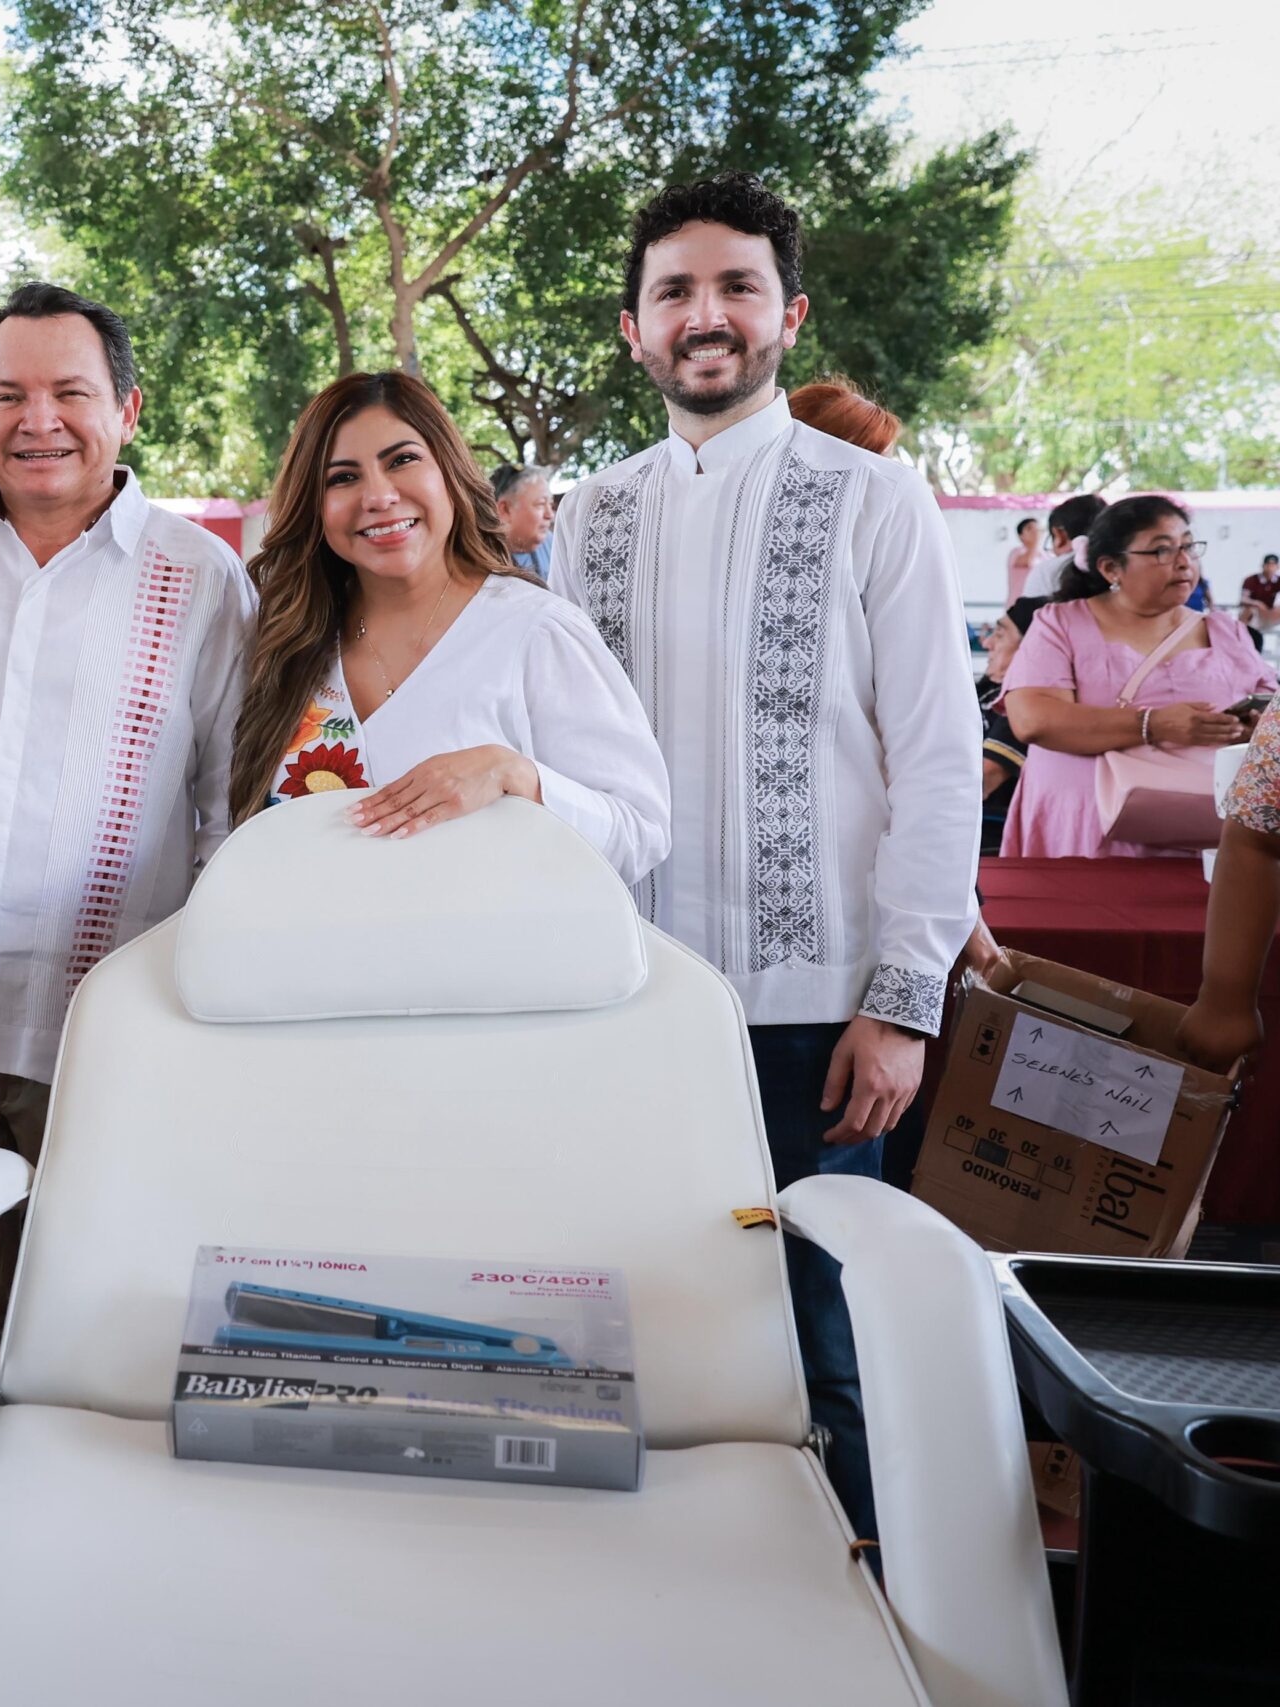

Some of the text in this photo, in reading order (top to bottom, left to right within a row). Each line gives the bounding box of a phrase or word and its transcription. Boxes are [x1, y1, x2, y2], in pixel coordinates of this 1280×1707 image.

[955, 1114, 1073, 1171] 40 30 20 10
[962, 1159, 1041, 1202] PERÓXIDO
[215, 1254, 246, 1265] 3,17
[318, 1260, 368, 1272] IÓNICA
[202, 1347, 234, 1356] Placas
[252, 1350, 277, 1358] Nano
[280, 1352, 322, 1361] Titanium
[333, 1355, 369, 1364] Control
[387, 1358, 448, 1369] Temperatura
[451, 1362, 483, 1371] Digital
